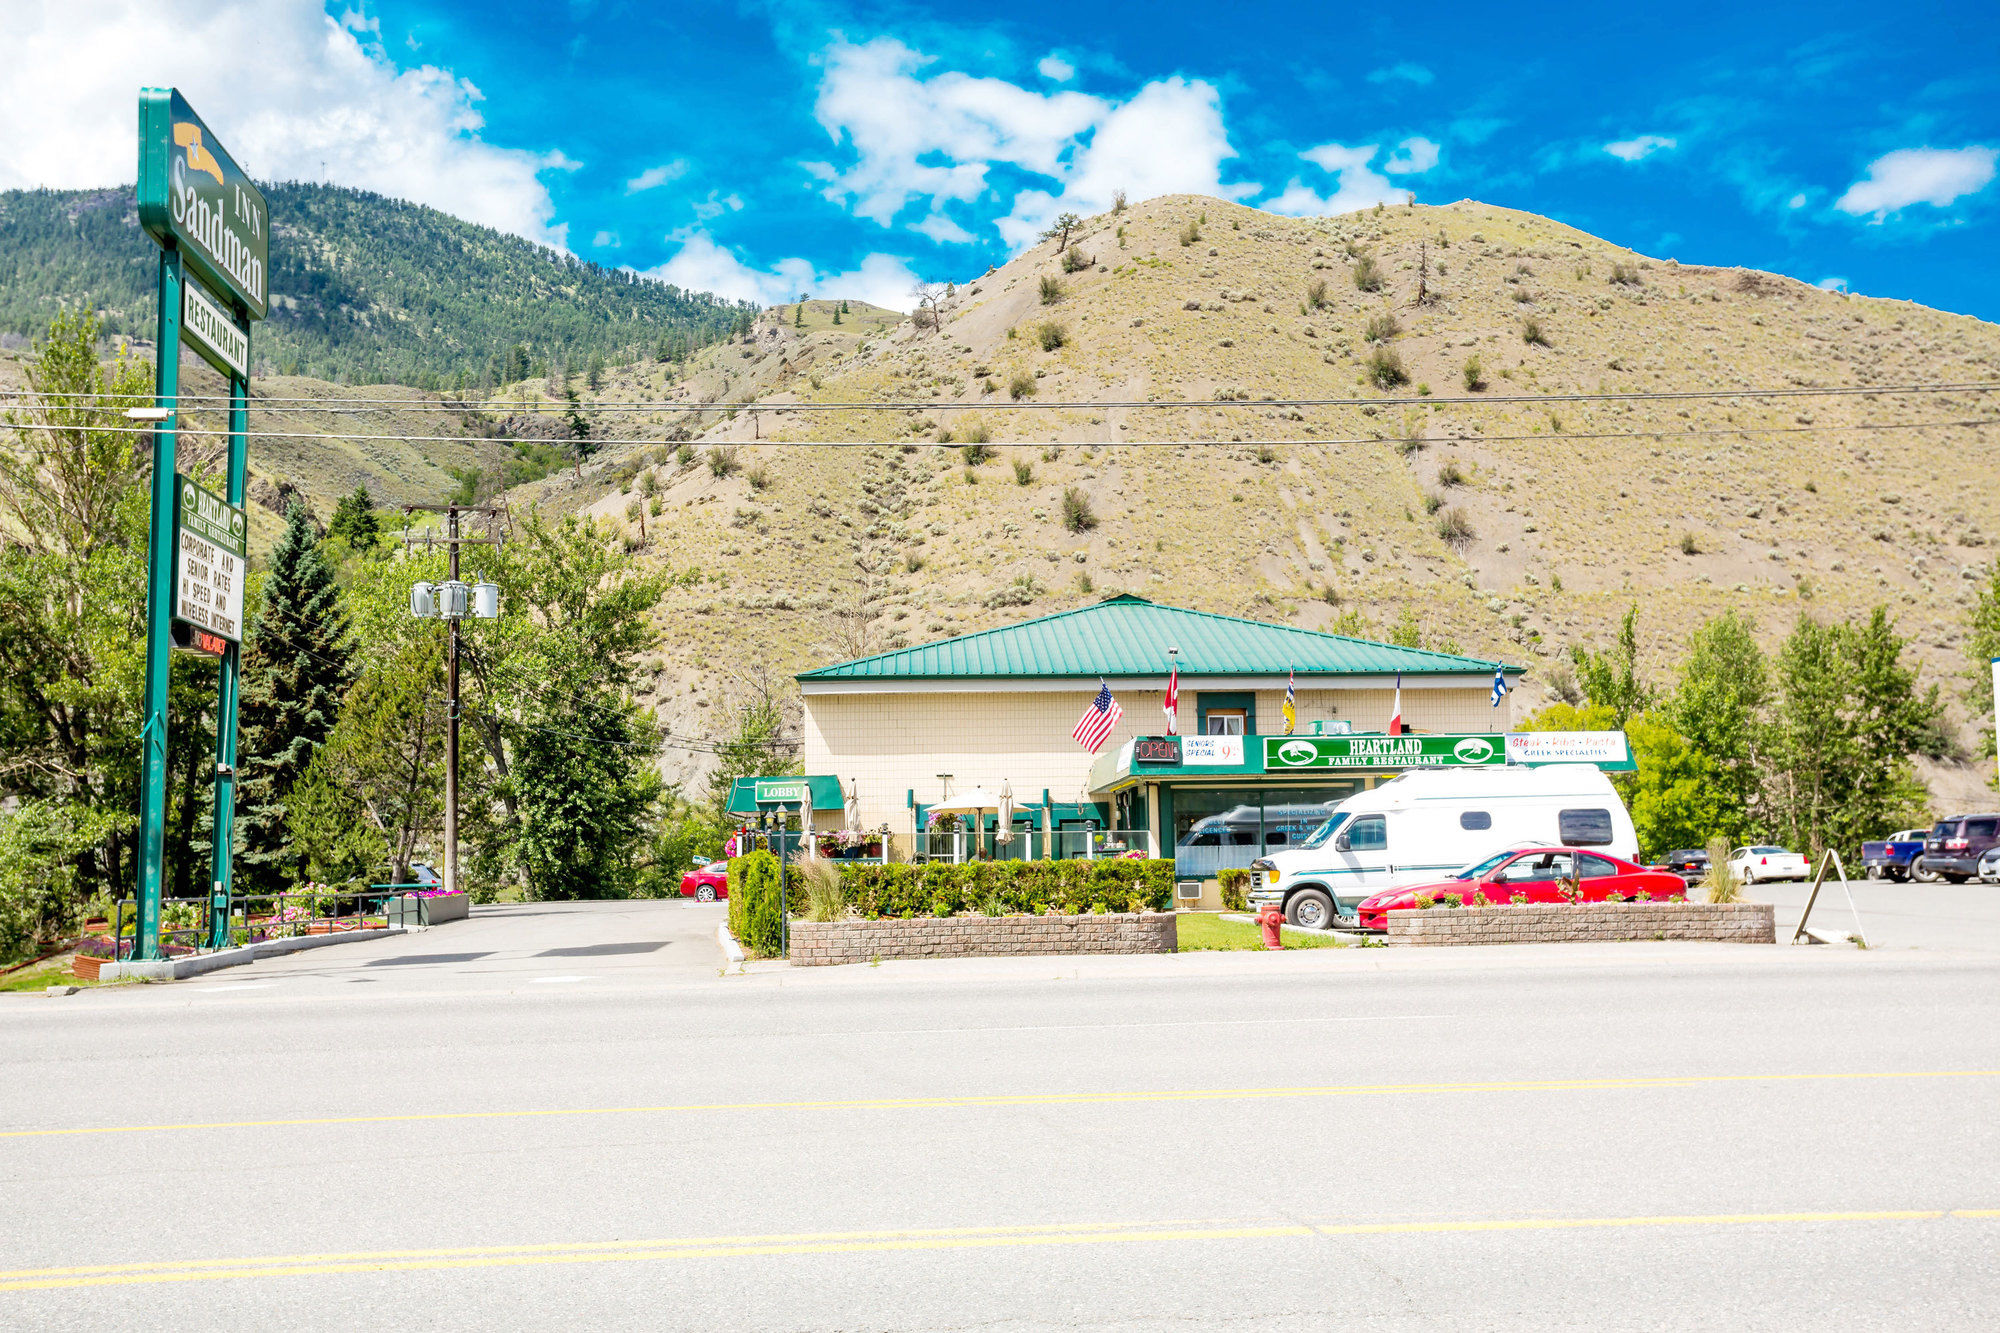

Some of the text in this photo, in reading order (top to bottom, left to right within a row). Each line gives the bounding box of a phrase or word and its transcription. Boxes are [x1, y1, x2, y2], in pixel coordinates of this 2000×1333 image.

[234, 183, 262, 241] INN
[173, 154, 263, 306] Sandman
[188, 293, 246, 368] RESTAURANT
[198, 490, 231, 532] HEARTLAND
[187, 512, 239, 551] FAMILY RESTAURANT
[181, 532, 234, 573] CORPORATE AND
[187, 558, 231, 593] SENIOR RATES
[182, 577, 226, 611] HI SPEED AND
[181, 599, 235, 635] WIRELESS INTERNET
[1140, 741, 1174, 758] OPEN
[1185, 749, 1215, 757] SPECIAL
[1349, 738, 1423, 755] HEARTLAND
[1512, 737, 1616, 747] Steak Ribs Pasta
[1328, 755, 1444, 766] FAMILY RESTAURANT
[764, 787, 800, 797] LOBBY
[1275, 824, 1297, 832] GREEK
